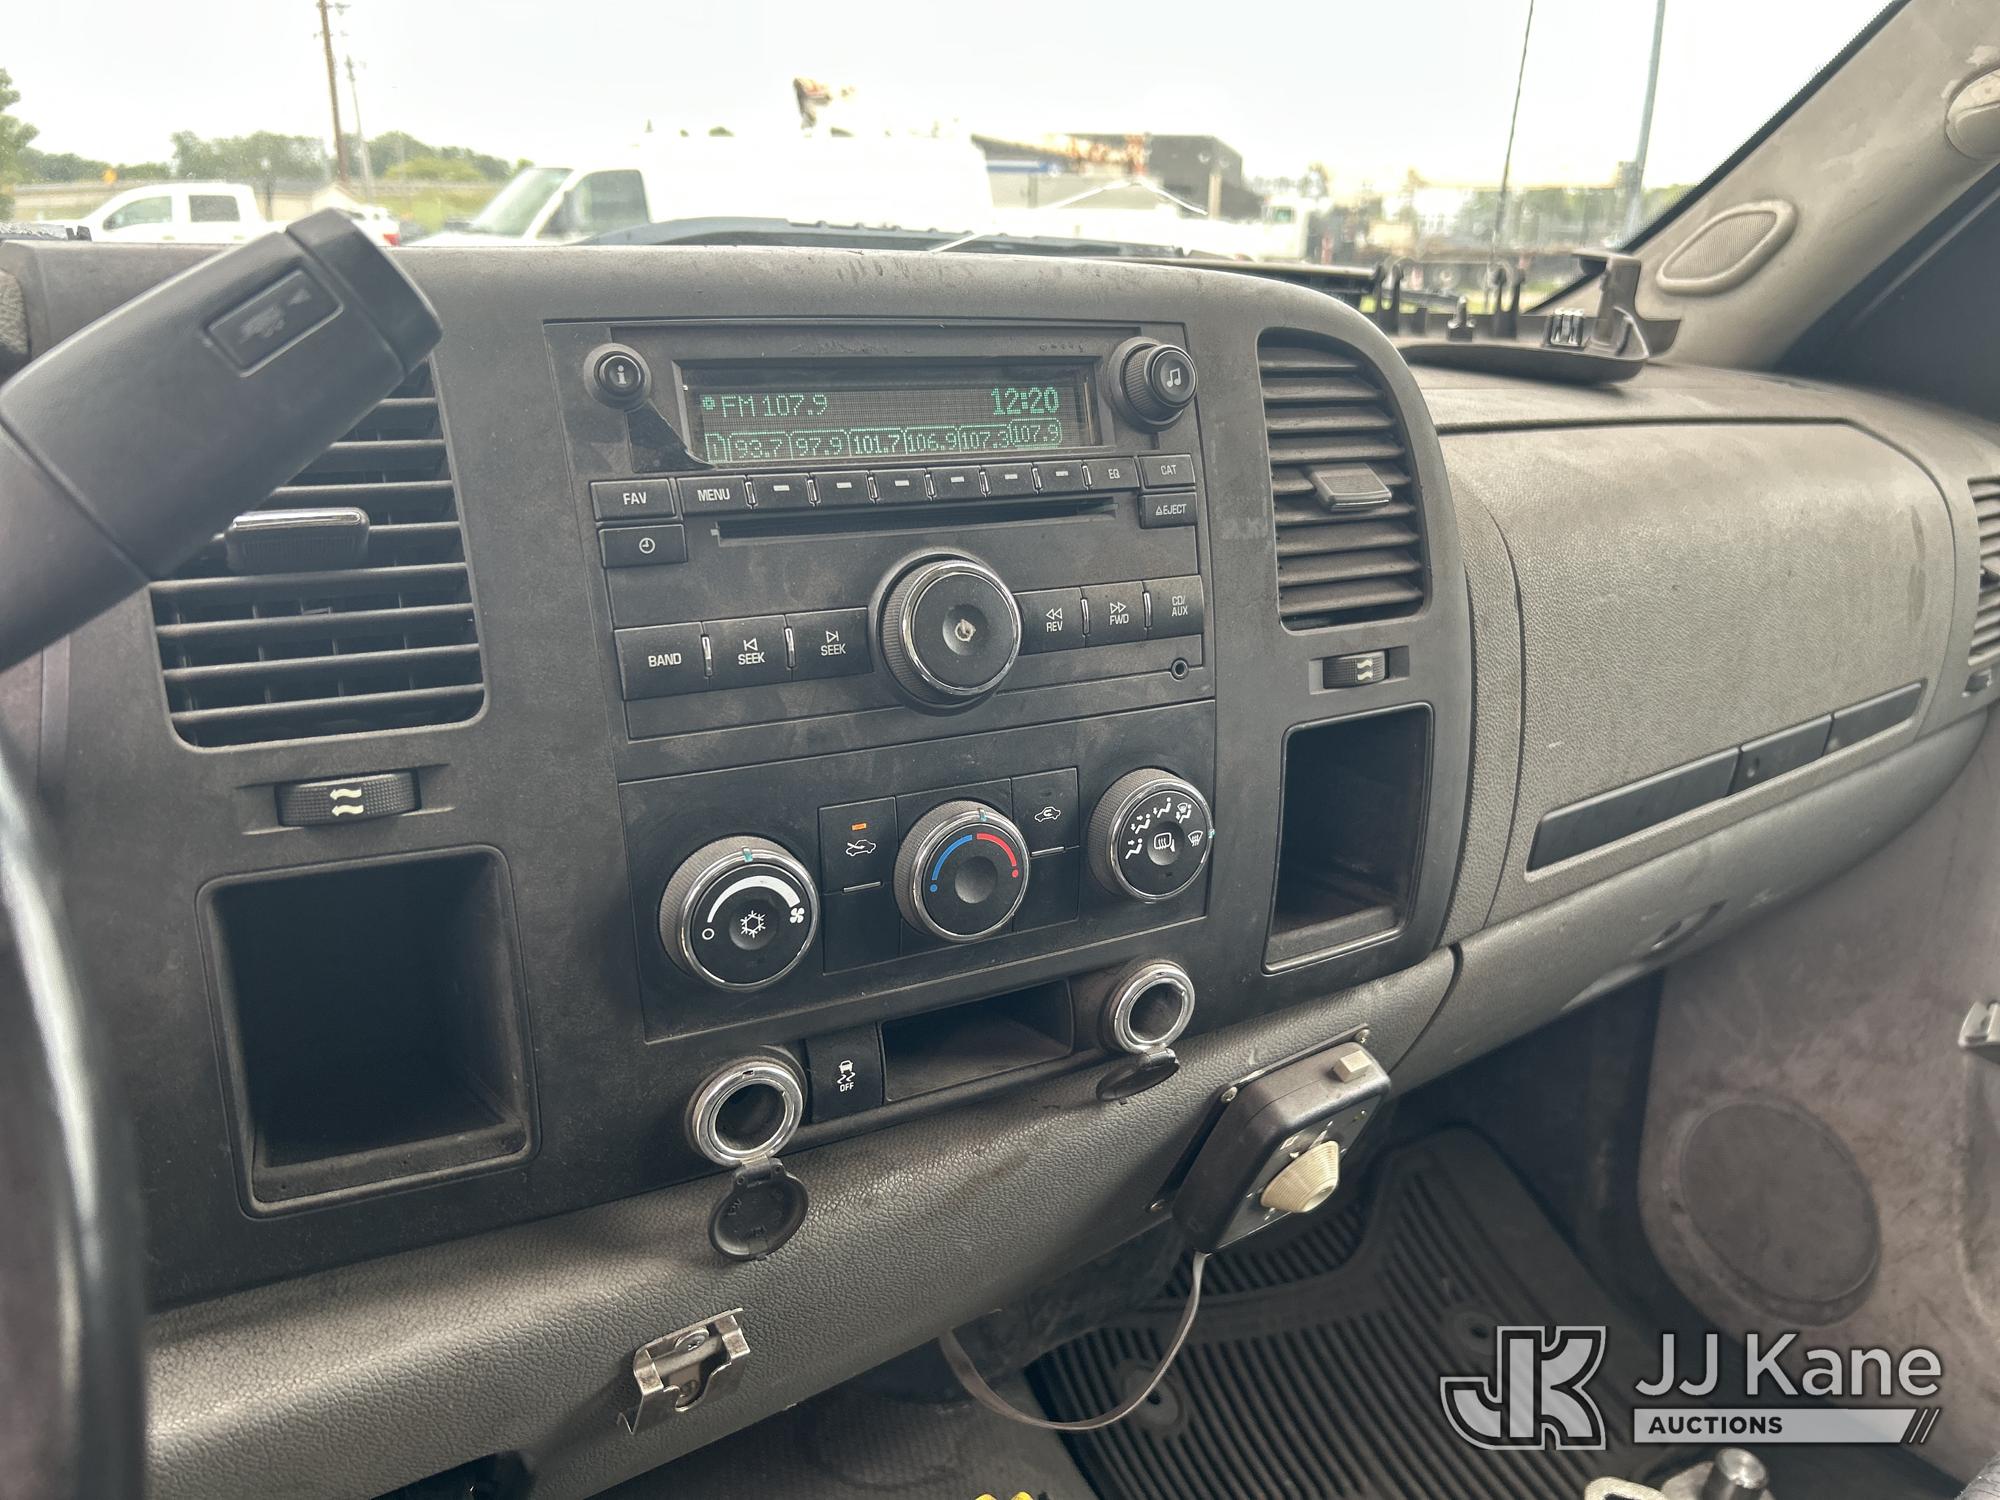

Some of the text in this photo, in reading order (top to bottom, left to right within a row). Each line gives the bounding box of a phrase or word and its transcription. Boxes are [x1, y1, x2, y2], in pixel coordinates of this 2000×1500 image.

[990, 386, 1060, 416] 12:20
[961, 430, 1009, 450] 107.3
[1011, 424, 1059, 443] 107.9
[735, 439, 783, 458] 93.7
[795, 436, 843, 456] 97.9
[853, 434, 900, 455] 101.7
[907, 432, 957, 453] 106.9
[1108, 468, 1120, 479] EQ
[1160, 464, 1177, 476] CAT
[622, 491, 647, 506] FAV
[697, 488, 730, 503] MENU
[1162, 503, 1187, 515] EJECT
[1171, 595, 1186, 606] CD/
[1171, 605, 1188, 617] AUX
[1046, 620, 1063, 633] REV
[1109, 614, 1130, 626] FWD
[820, 643, 847, 657] SEEK
[647, 652, 682, 668] BAND
[737, 651, 766, 666] SEEK
[839, 1081, 854, 1092] OFF
